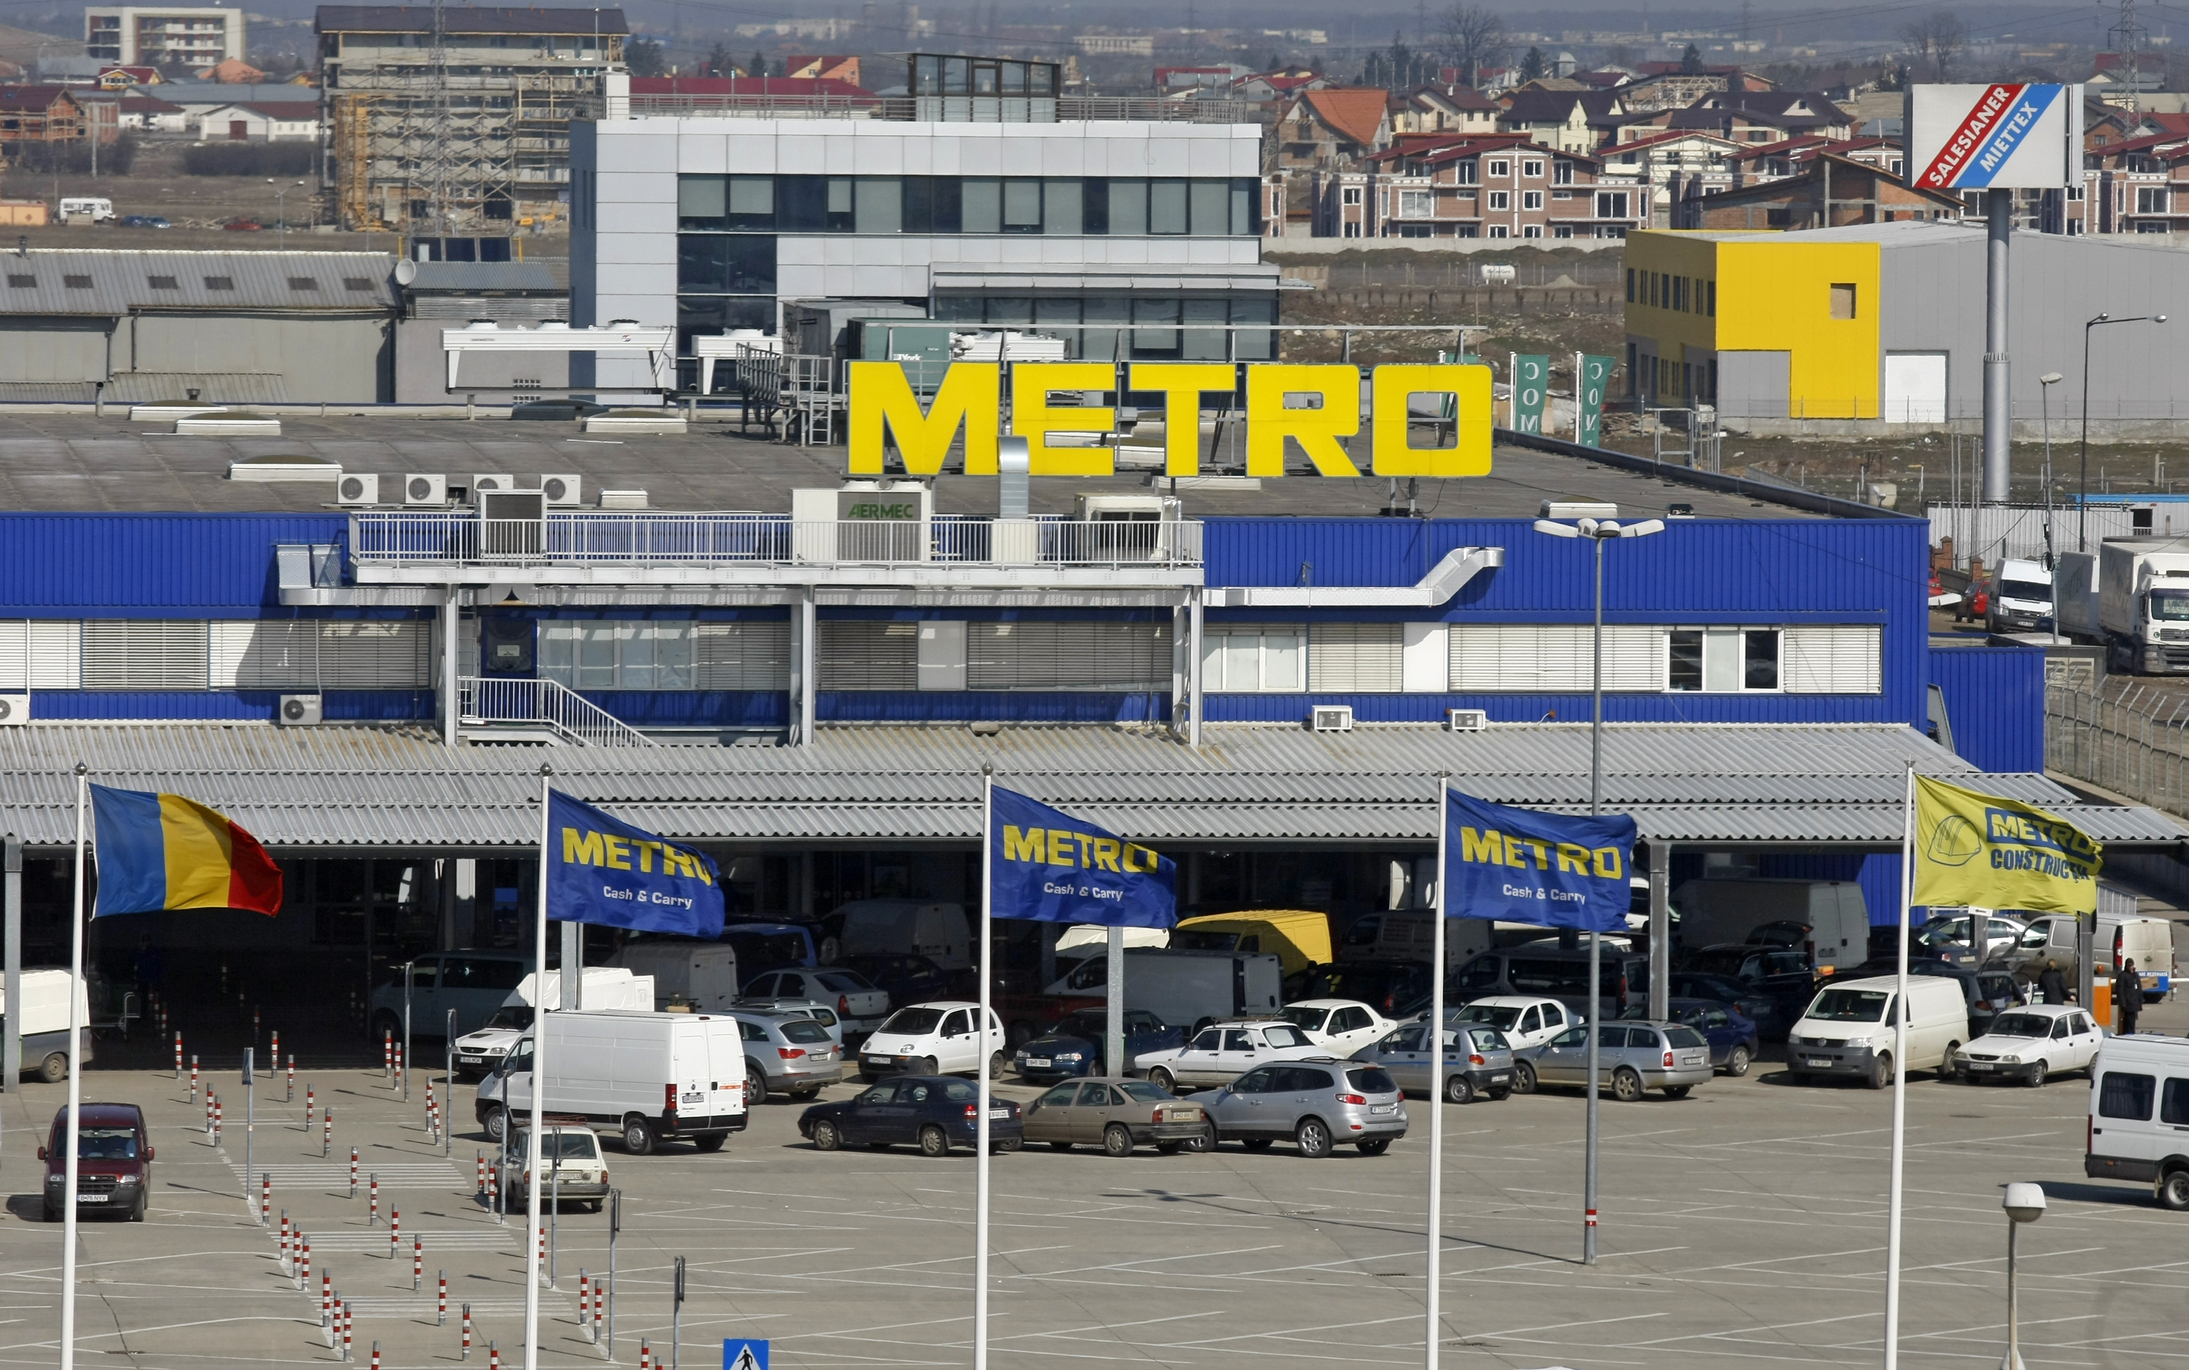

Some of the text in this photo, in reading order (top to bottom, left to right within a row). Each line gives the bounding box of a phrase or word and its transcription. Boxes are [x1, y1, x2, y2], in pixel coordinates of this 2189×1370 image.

[1929, 86, 2010, 186] SALESIANER
[1980, 101, 2038, 172] MIETTEX
[847, 361, 1493, 478] METRO
[848, 503, 913, 519] AERMEC
[1003, 824, 1158, 874] METRO
[1460, 826, 1622, 880] METRO
[1991, 813, 2094, 855] METRO
[603, 886, 693, 910] Cash & Carry
[1044, 882, 1123, 902] Cash & Carry
[1503, 884, 1585, 905] Cash & Carry
